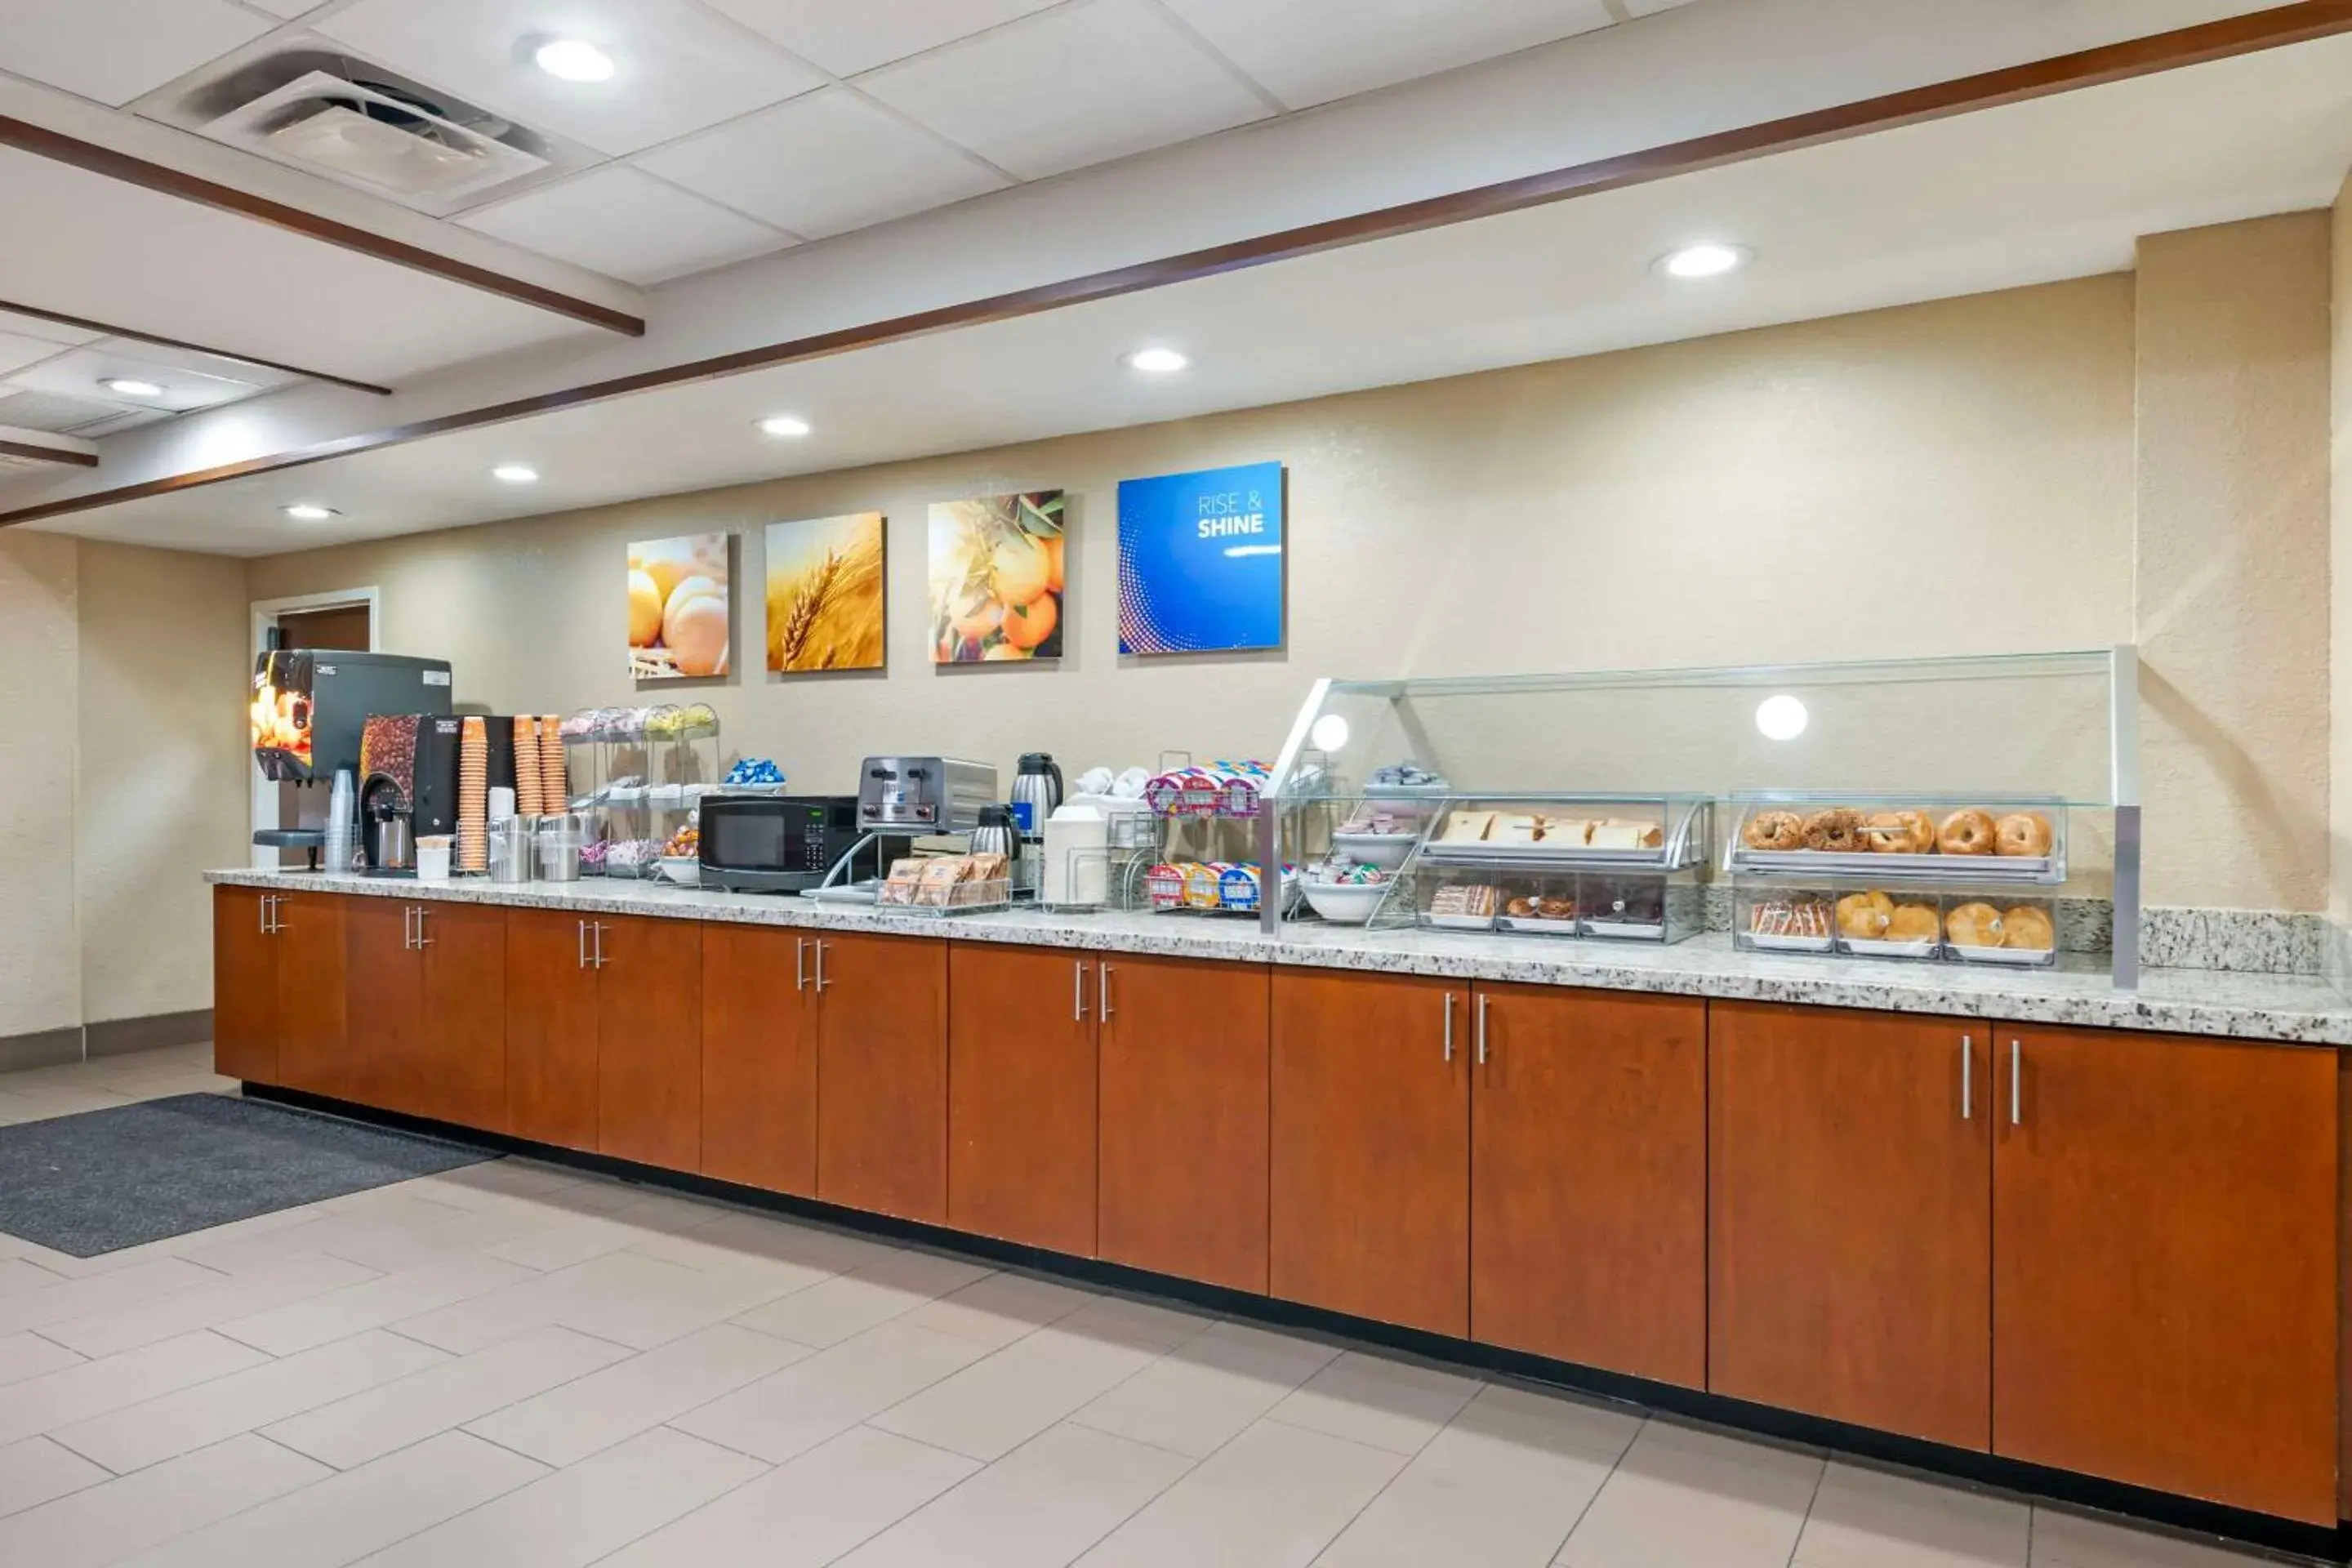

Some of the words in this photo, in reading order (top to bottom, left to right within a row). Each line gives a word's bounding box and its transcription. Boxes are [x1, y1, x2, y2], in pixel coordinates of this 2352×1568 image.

[1198, 492, 1241, 515] RISE
[1247, 489, 1262, 511] &
[1197, 513, 1264, 538] SHINE
